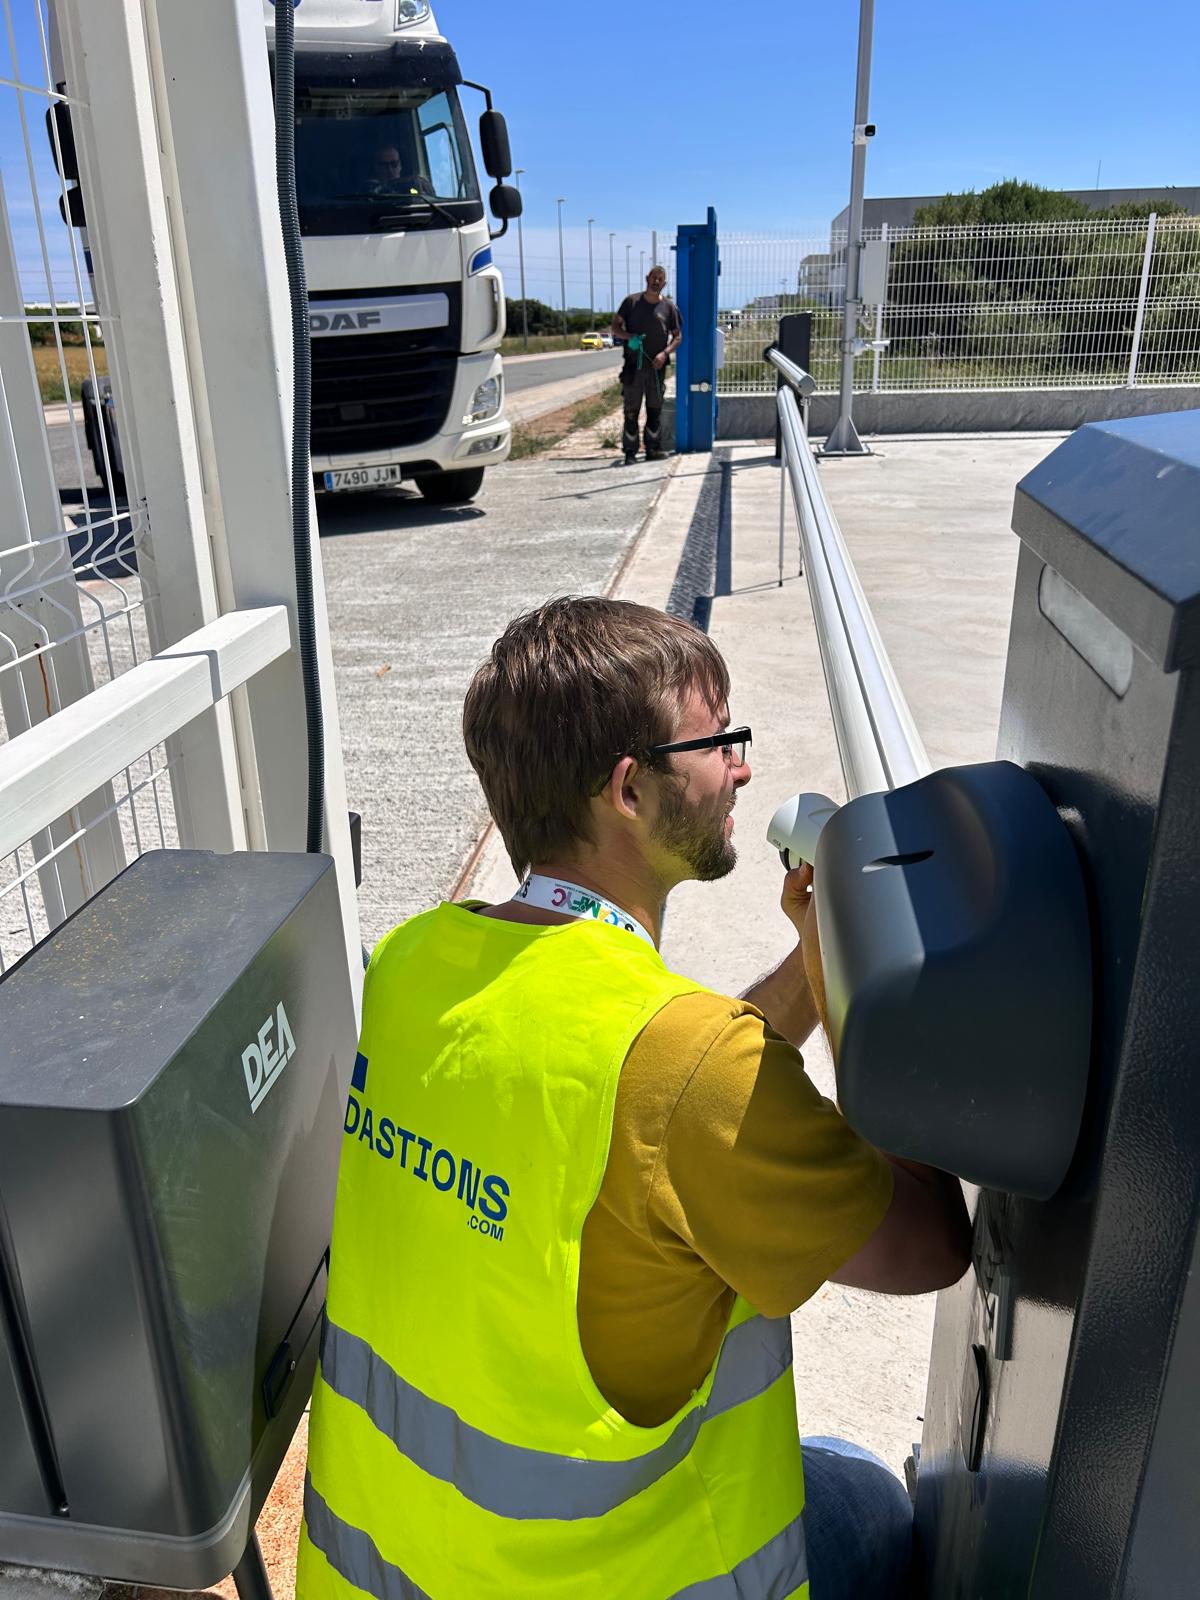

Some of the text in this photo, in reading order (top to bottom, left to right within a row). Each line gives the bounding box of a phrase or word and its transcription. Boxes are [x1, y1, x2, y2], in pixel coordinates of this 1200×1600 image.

[309, 311, 381, 331] DAF
[334, 470, 369, 487] 7490
[241, 1001, 297, 1103] DEA
[467, 1215, 504, 1241] .COM
